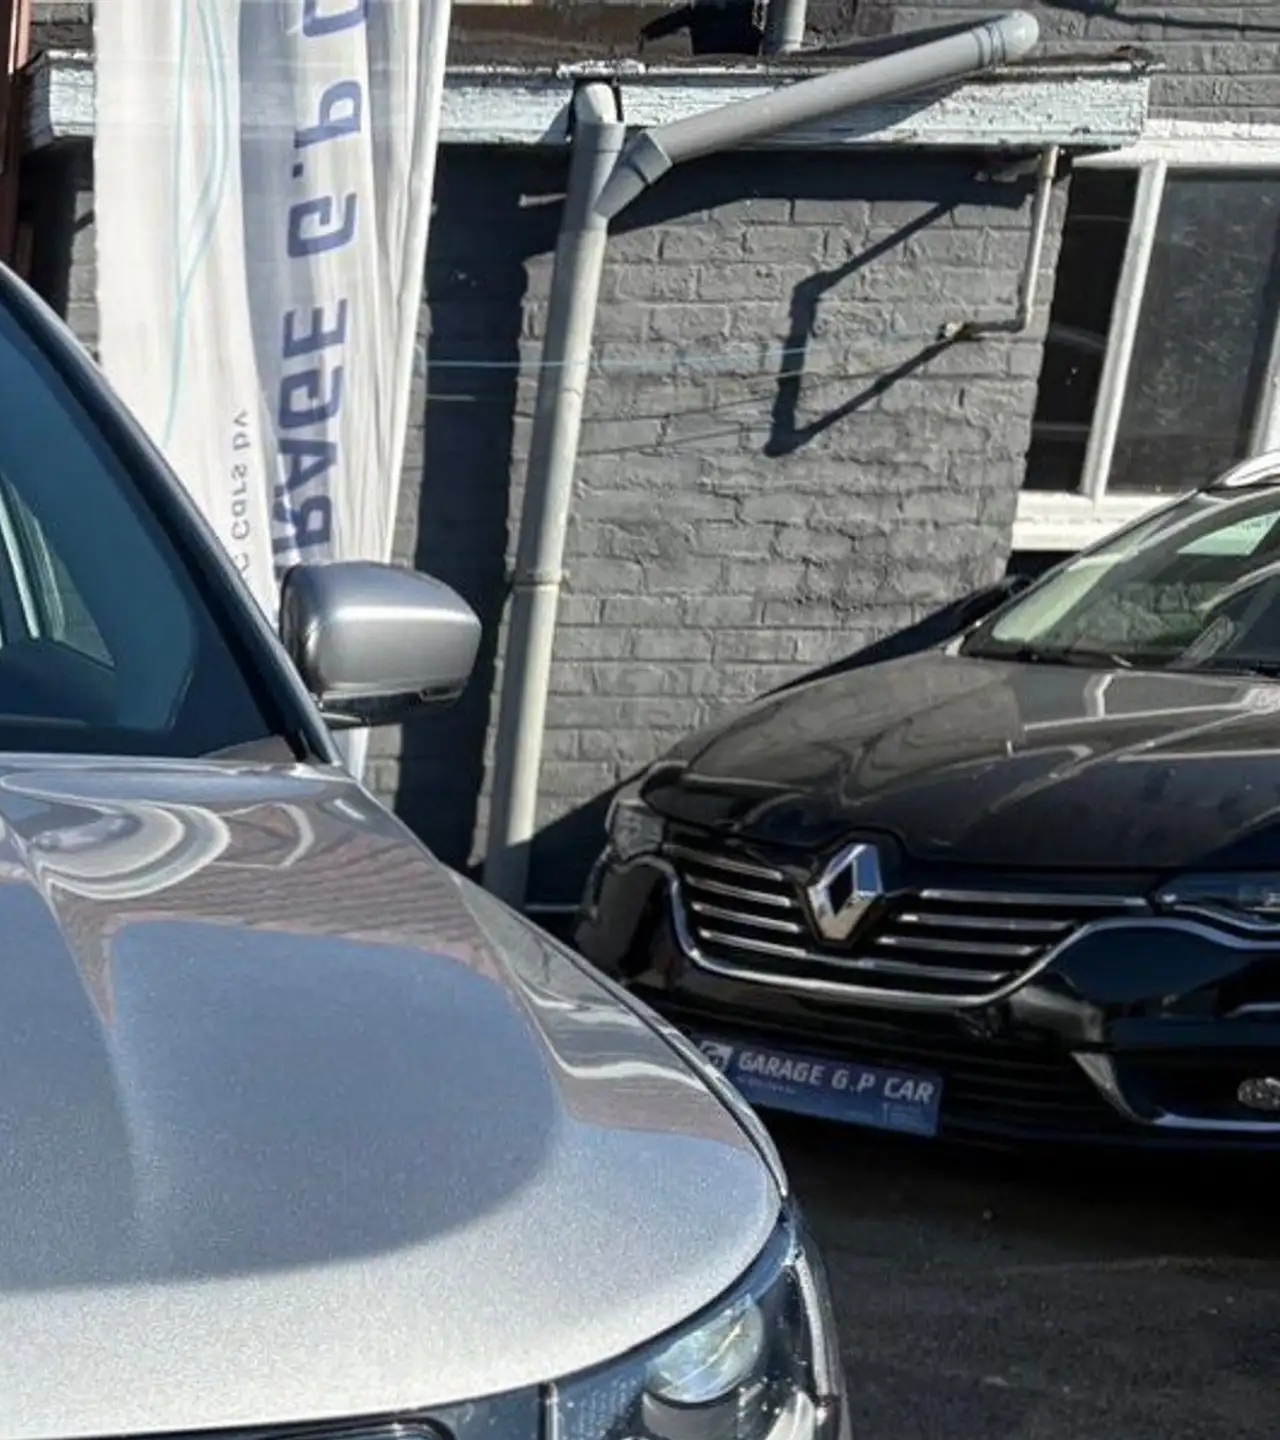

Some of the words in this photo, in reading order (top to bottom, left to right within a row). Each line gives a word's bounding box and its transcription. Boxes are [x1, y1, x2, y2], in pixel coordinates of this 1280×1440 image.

[737, 1051, 825, 1086] GARAGE
[831, 1070, 876, 1093] G.P
[883, 1078, 934, 1105] CAR
